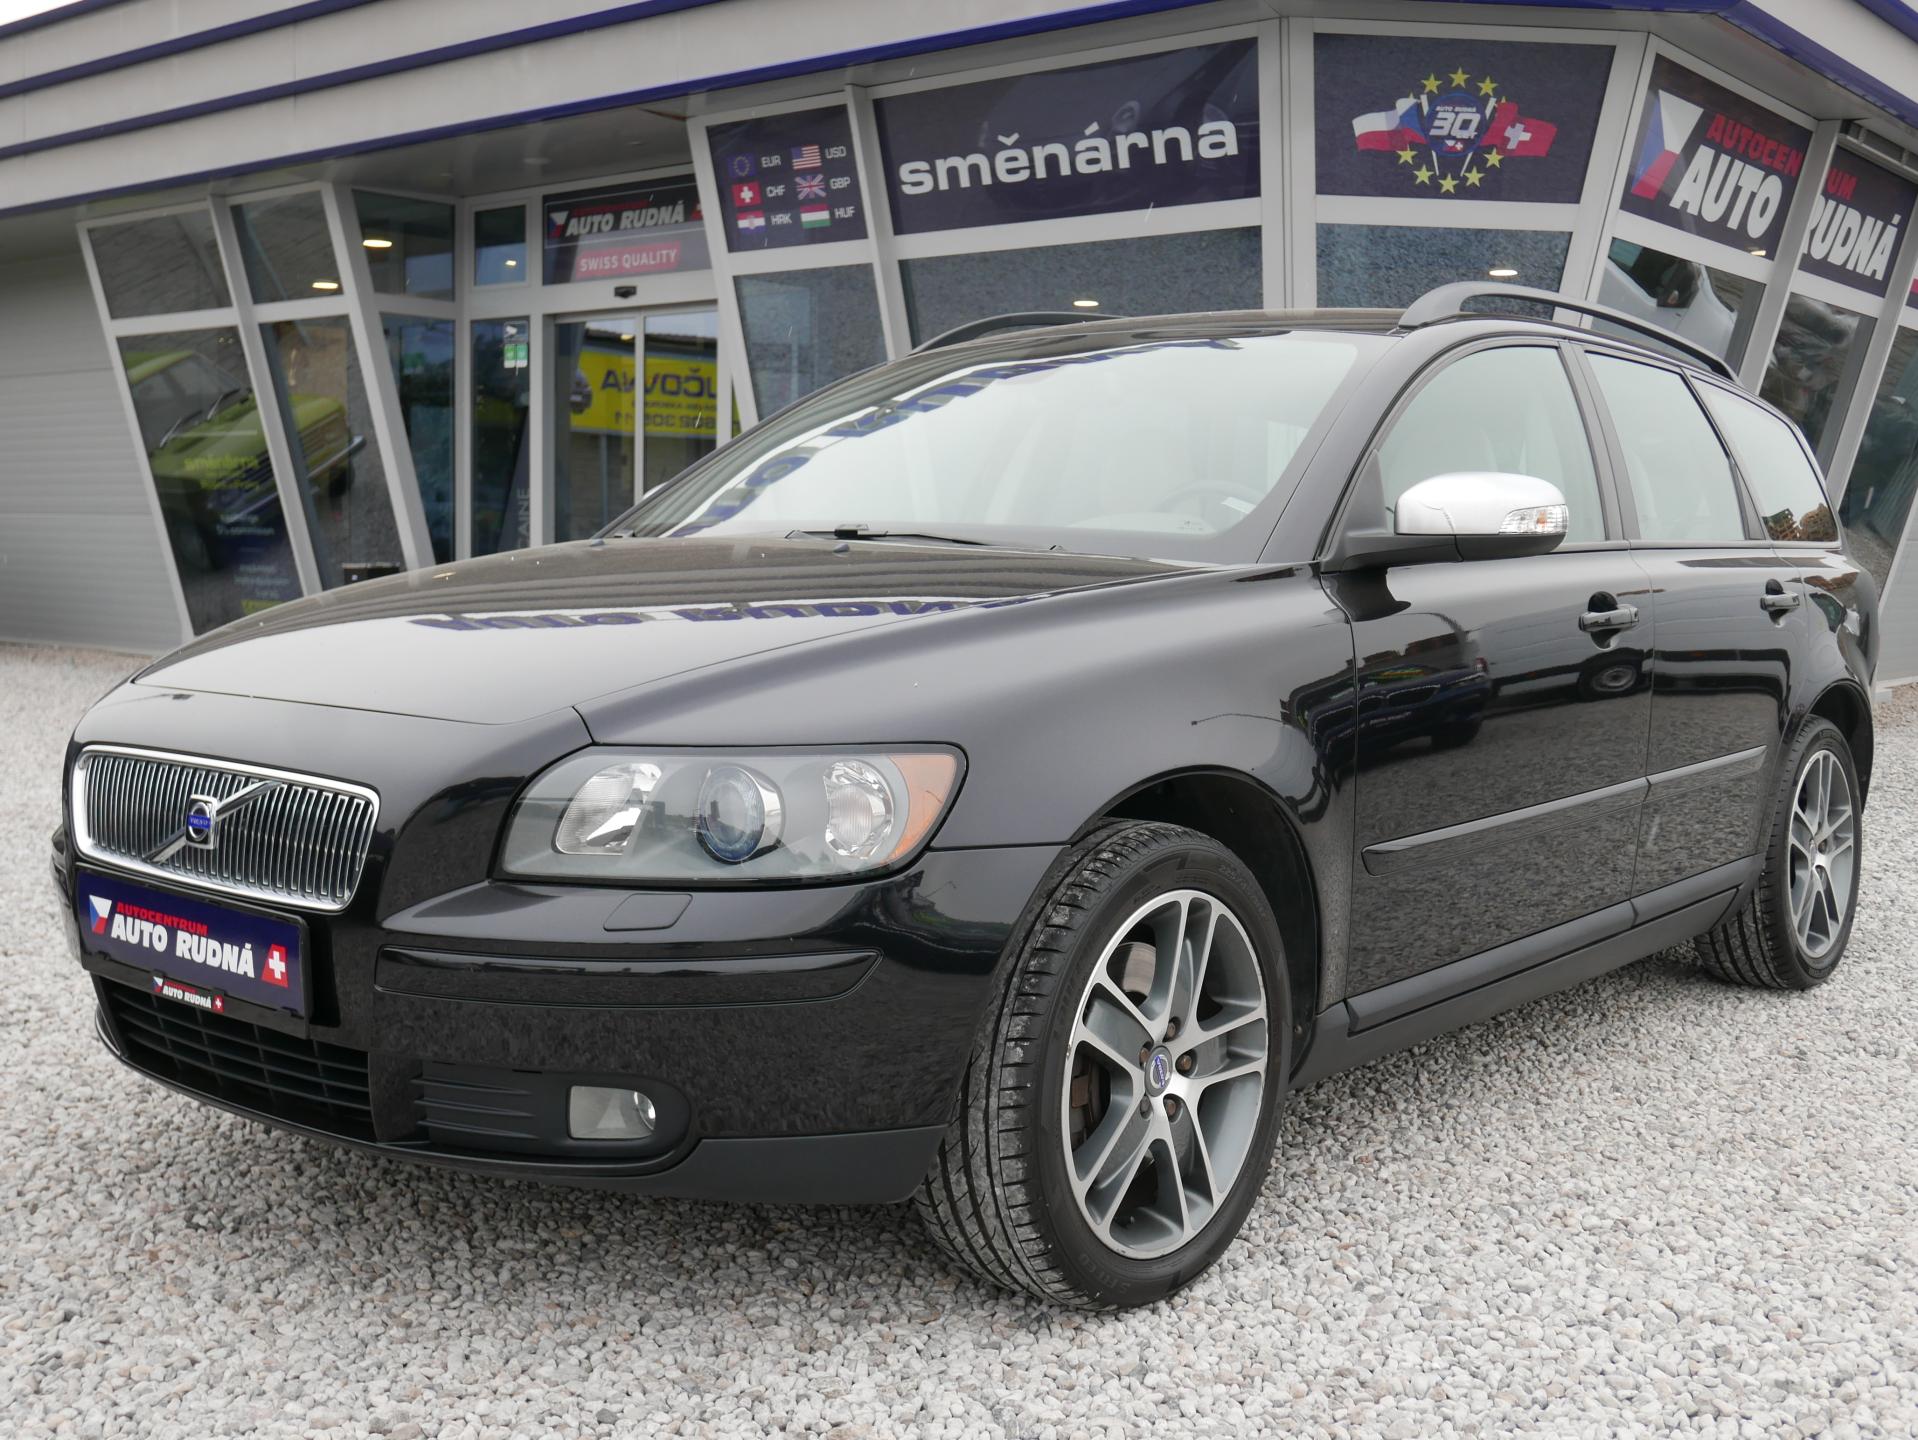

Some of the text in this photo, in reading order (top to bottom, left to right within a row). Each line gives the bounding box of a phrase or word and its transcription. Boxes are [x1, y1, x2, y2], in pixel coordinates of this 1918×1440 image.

[1429, 111, 1481, 137] 30
[761, 155, 782, 168] EUR
[825, 146, 847, 159] USD
[900, 119, 1239, 195] směnárna
[765, 184, 786, 197] CHF
[829, 176, 851, 189] GBP
[1669, 144, 1783, 239] AUTO
[565, 213, 614, 237] AUTO
[620, 200, 685, 230] RUDNÁ
[834, 206, 855, 219] HUF
[580, 249, 677, 272] SWISS QUALITY
[116, 902, 208, 936] AUTOCENTRUM
[111, 913, 255, 978] AUTO RUDNÁ
[163, 985, 183, 1000] AUTO
[184, 991, 212, 1009] RUDNÁ
